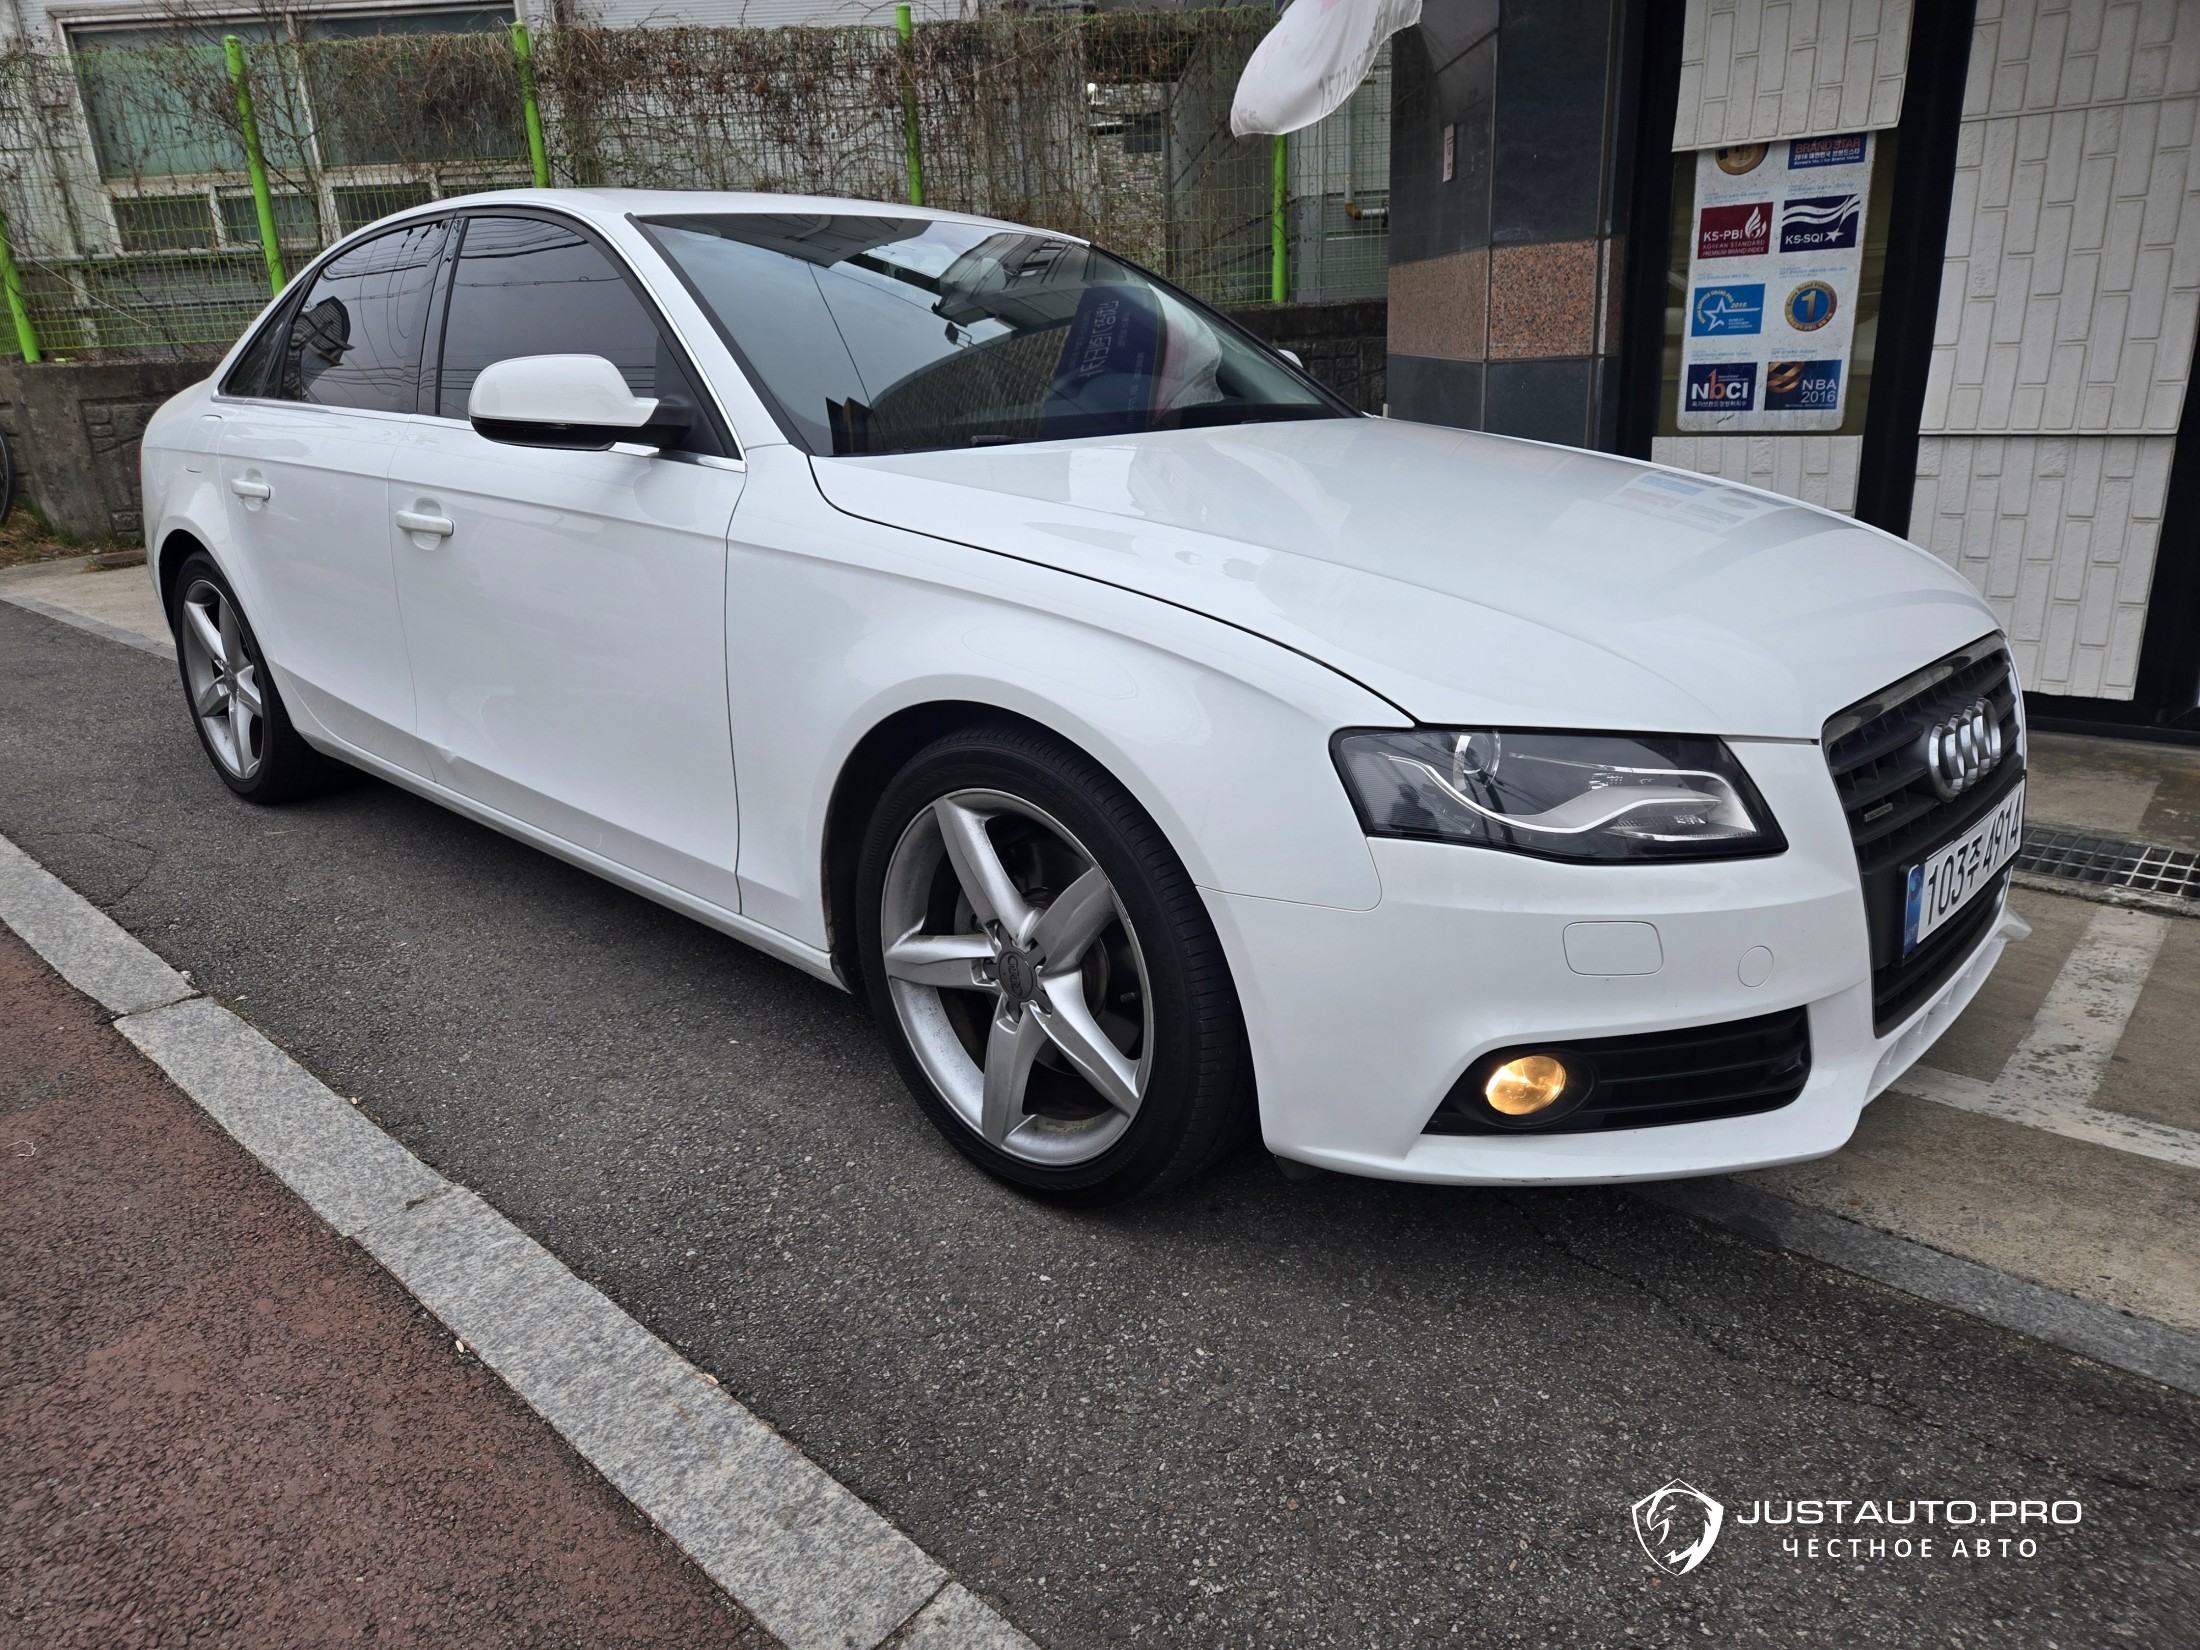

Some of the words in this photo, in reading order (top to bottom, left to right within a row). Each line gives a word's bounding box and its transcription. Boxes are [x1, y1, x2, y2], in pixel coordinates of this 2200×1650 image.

[1795, 141, 1832, 154] BRAND
[1833, 137, 1861, 150] STAR
[1703, 229, 1743, 242] KS-PBI
[1785, 232, 1824, 245] KS-SQI
[1730, 239, 1765, 248] STANDARD
[1702, 249, 1726, 257] PREMIUM
[1727, 247, 1746, 255] BRAND
[1747, 246, 1765, 254] INDEX
[1801, 290, 1817, 323] 1
[1802, 378, 1837, 391] NBA
[1800, 390, 1837, 403] 2016
[1927, 834, 1983, 926] 103주
[1981, 791, 2022, 874] 4914
